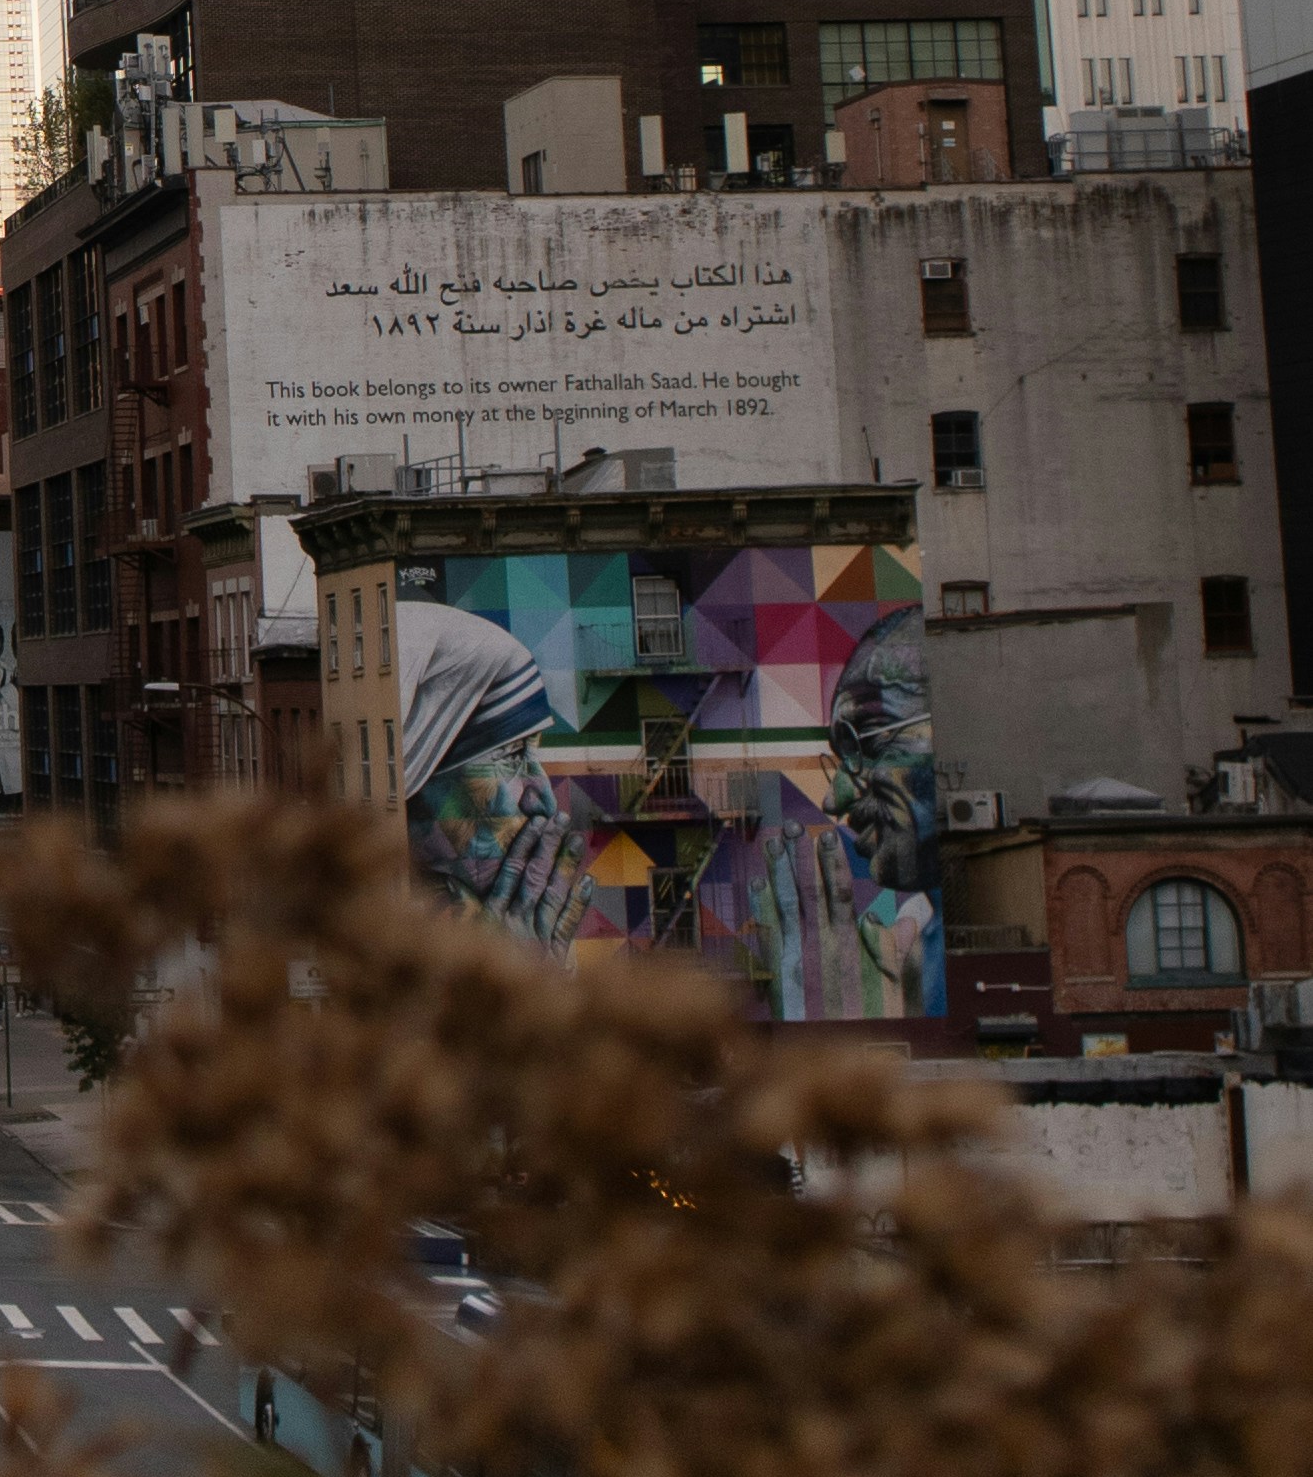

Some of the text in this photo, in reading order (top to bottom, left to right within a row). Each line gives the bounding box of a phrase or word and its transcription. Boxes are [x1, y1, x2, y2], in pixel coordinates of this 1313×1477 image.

[325, 261, 793, 306] هذا الكتاب يخص صاحبه فتح الله سعد
[373, 312, 441, 338] ١٨٩٢
[452, 310, 501, 334] سنة
[509, 309, 552, 340] اذار
[564, 309, 608, 339] غرة
[674, 310, 709, 335] من
[720, 302, 796, 333] اشتراه
[265, 370, 802, 400] This book belongs to its owner Fathallah Saad. He bought
[266, 398, 774, 428] it with his own money at the beginning of March 1892.
